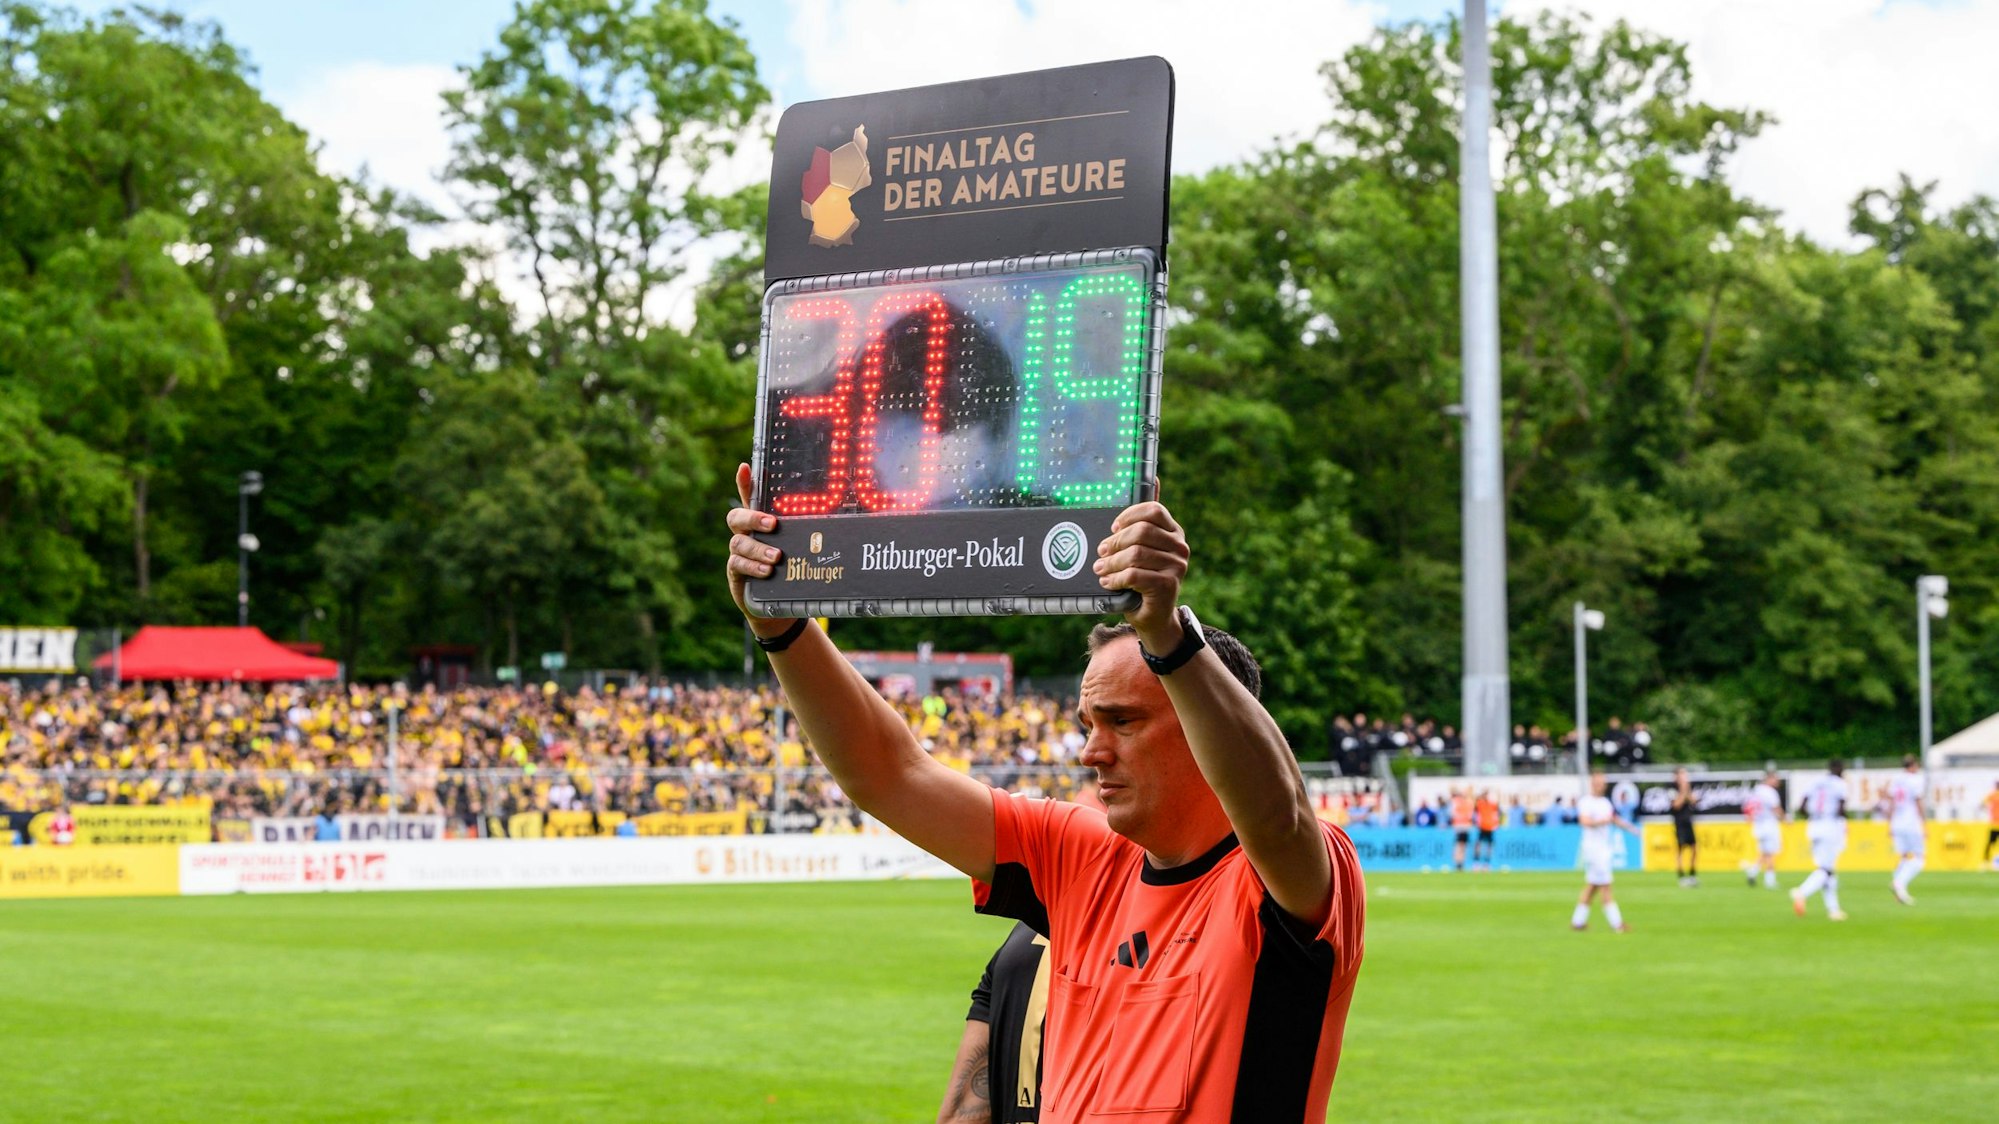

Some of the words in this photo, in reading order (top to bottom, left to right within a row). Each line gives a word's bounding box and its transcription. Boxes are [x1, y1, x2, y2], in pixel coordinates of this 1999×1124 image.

[885, 132, 1036, 176] FINALTAG
[883, 177, 943, 212] DER
[951, 158, 1127, 205] AMATEURE
[773, 291, 948, 514] 30
[1016, 273, 1143, 504] 19
[785, 557, 845, 584] Bitburger
[860, 536, 1025, 578] Bitburger-Pokal
